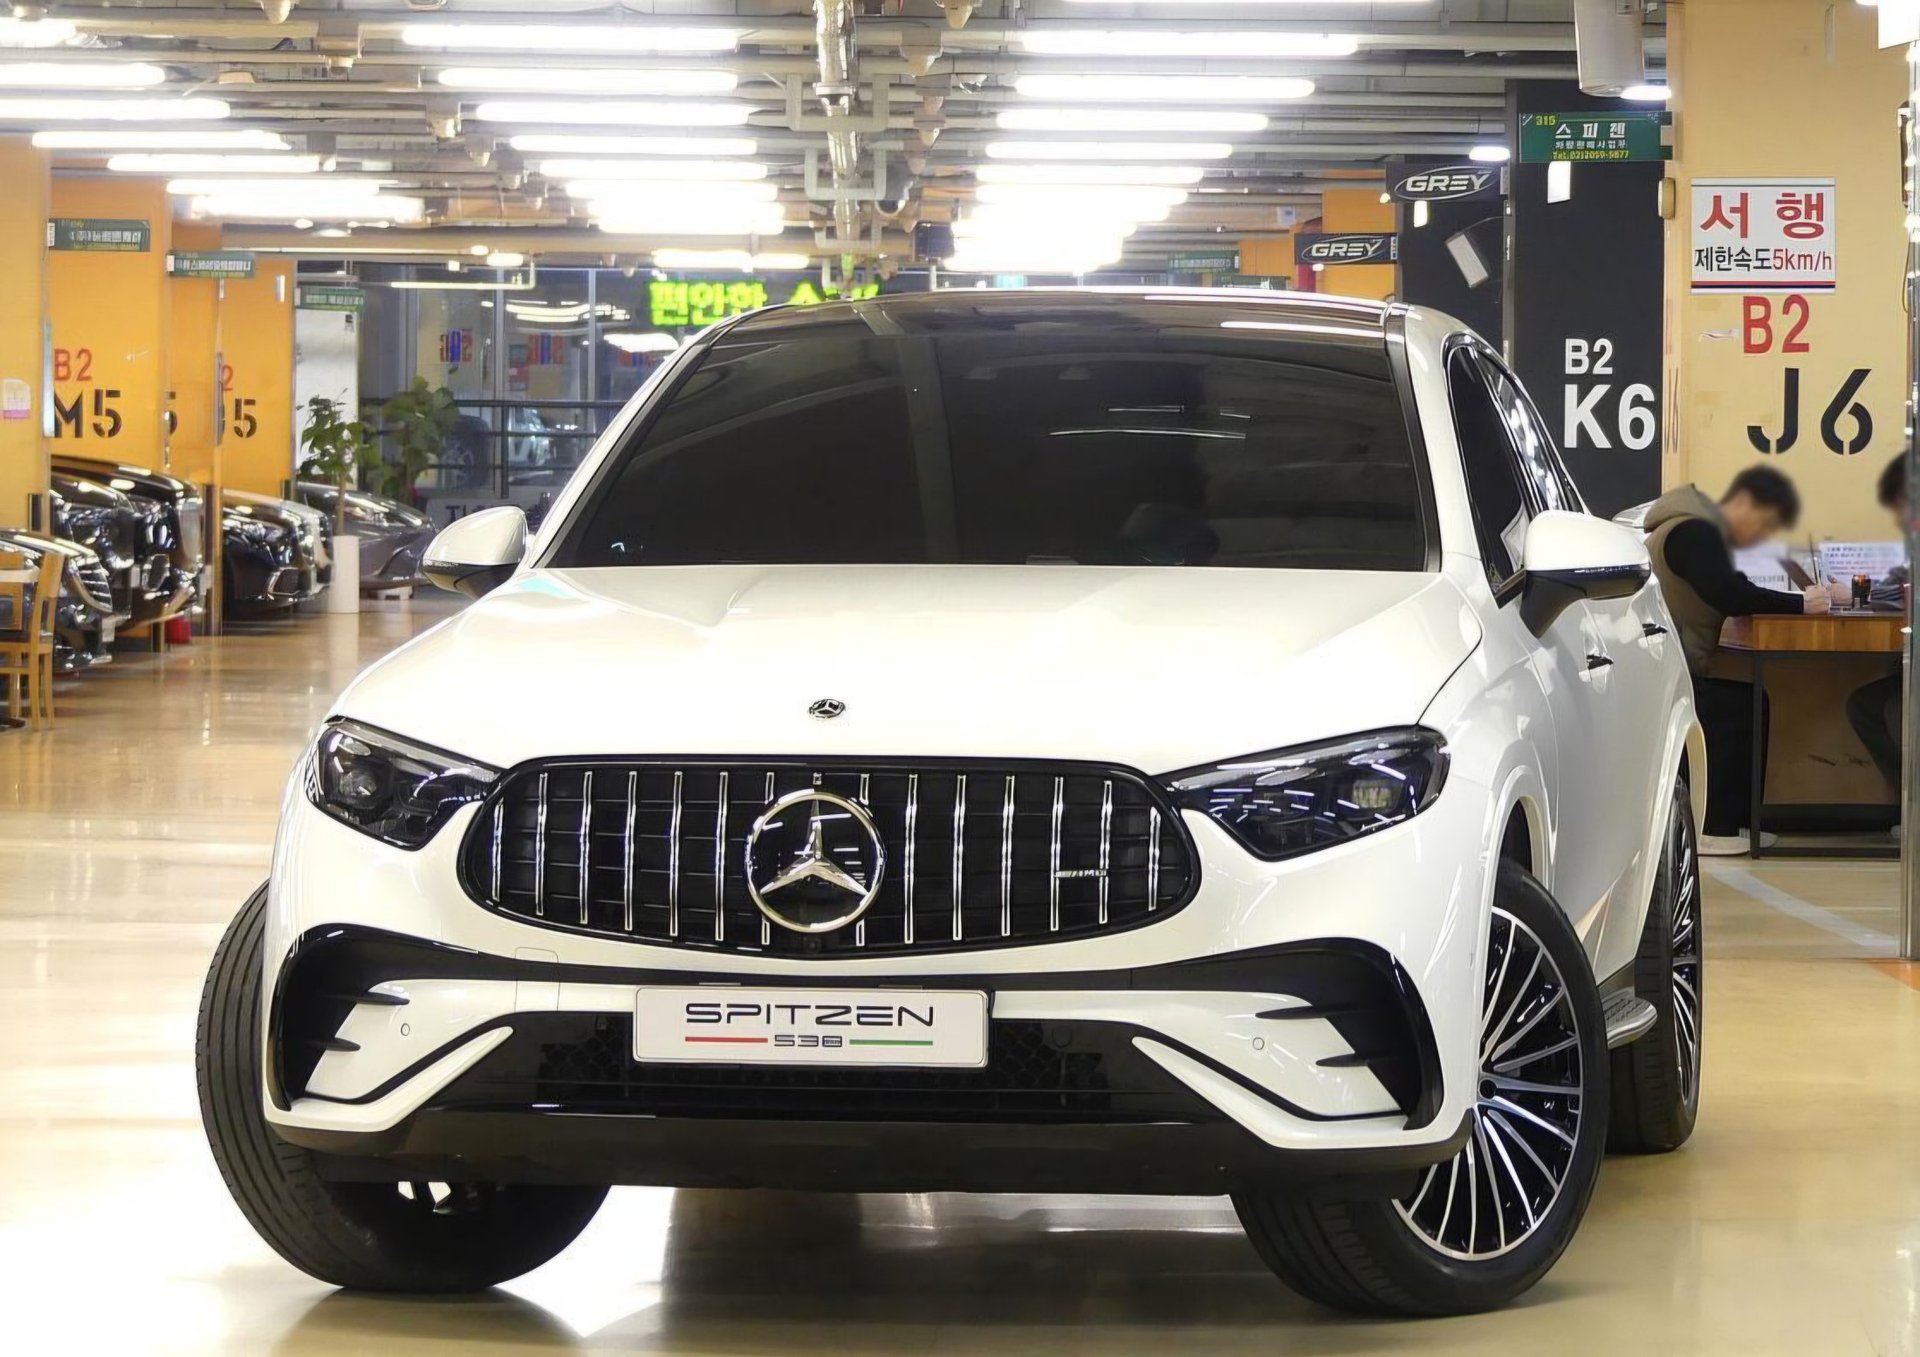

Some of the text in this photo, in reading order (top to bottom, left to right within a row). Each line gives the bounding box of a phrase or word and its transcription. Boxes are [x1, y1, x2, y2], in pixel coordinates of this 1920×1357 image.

[1406, 174, 1490, 192] GREY
[1311, 242, 1378, 257] GREY
[1743, 294, 1810, 354] B2
[54, 348, 92, 381] B2
[1565, 338, 1613, 374] B2
[53, 388, 122, 438] M5
[1564, 383, 1656, 450] K6
[1747, 367, 1873, 455] J6
[685, 1003, 934, 1027] SPITZEN
